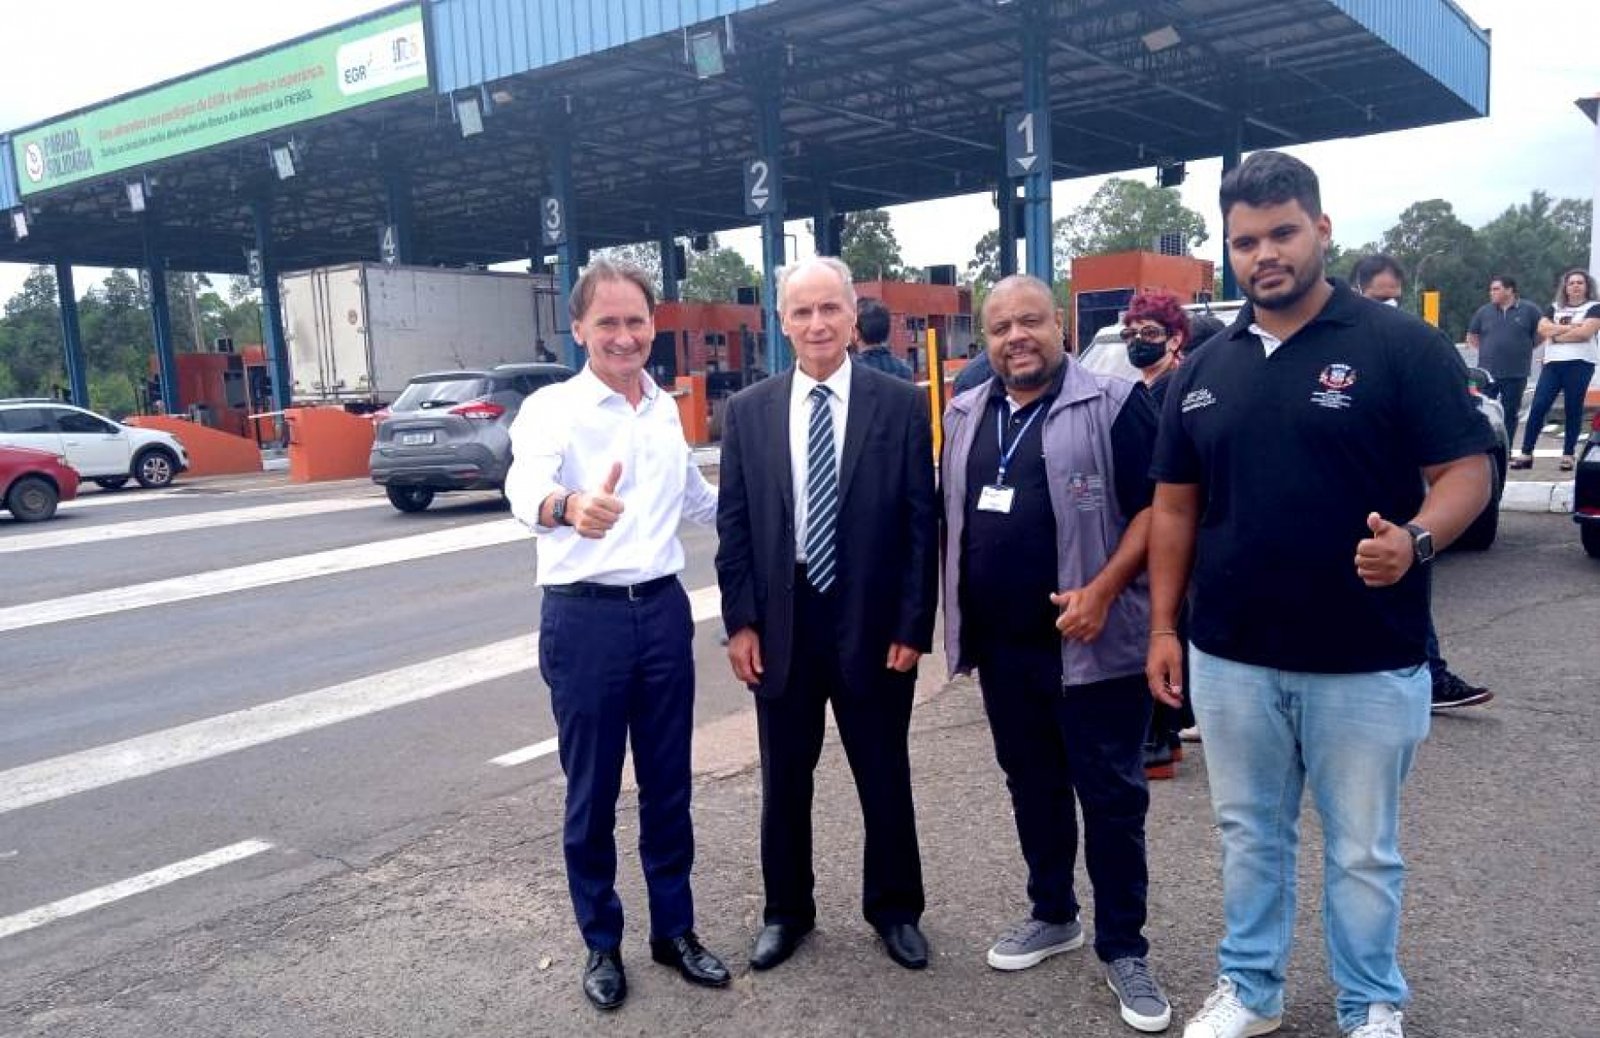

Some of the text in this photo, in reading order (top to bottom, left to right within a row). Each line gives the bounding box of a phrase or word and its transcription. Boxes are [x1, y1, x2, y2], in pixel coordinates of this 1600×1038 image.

[344, 65, 367, 84] EGR
[1017, 113, 1034, 153] 1
[750, 161, 769, 196] 2
[546, 198, 560, 228] 3
[383, 227, 395, 254] 4
[250, 250, 260, 275] 5
[141, 269, 150, 292] 6
